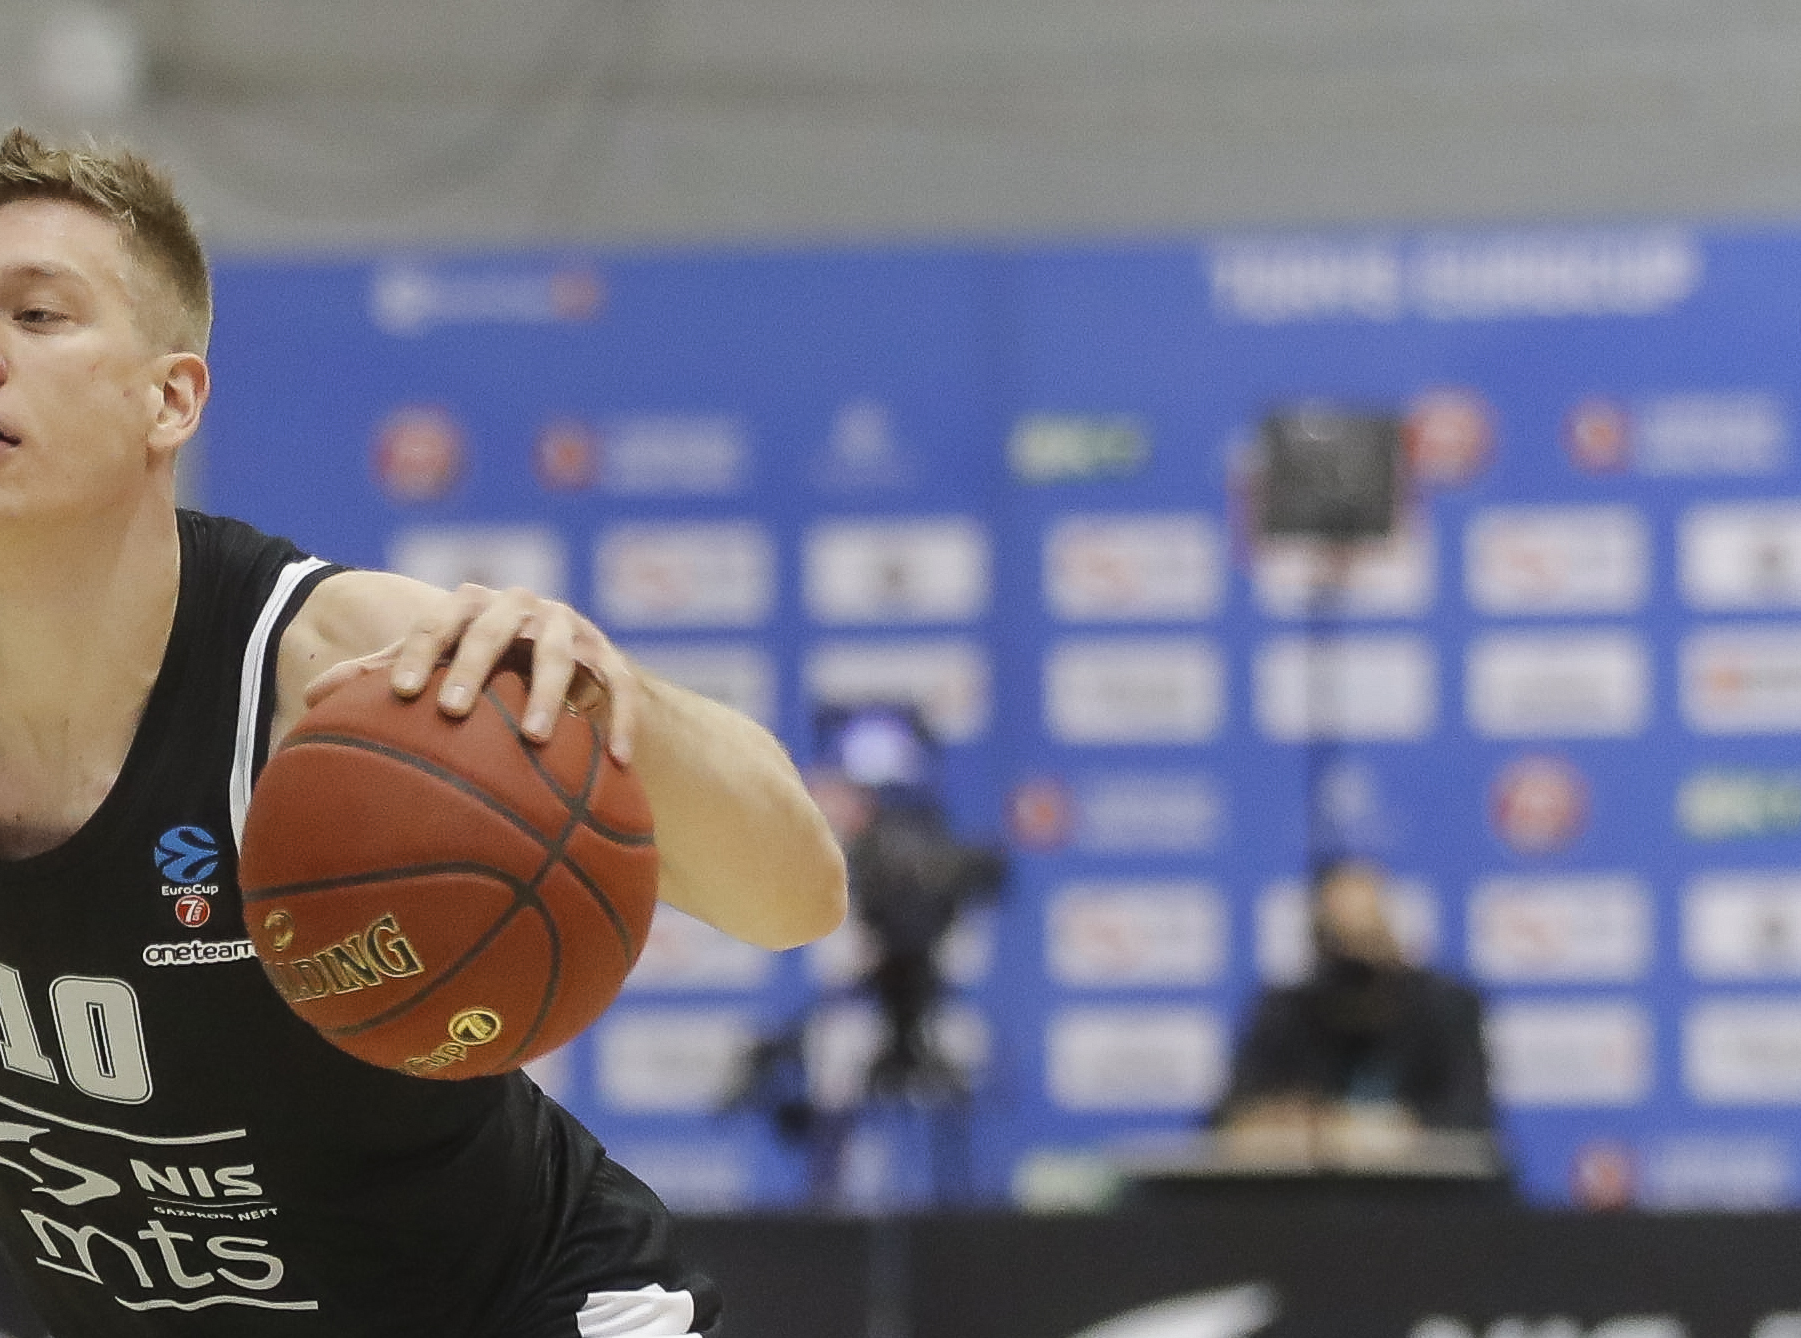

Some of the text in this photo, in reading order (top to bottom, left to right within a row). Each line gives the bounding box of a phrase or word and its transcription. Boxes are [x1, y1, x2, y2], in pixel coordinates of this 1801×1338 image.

[161, 883, 220, 896] EuroCup
[130, 1158, 263, 1198] NIS
[237, 1207, 279, 1222] NEFT
[20, 1208, 285, 1290] mts
